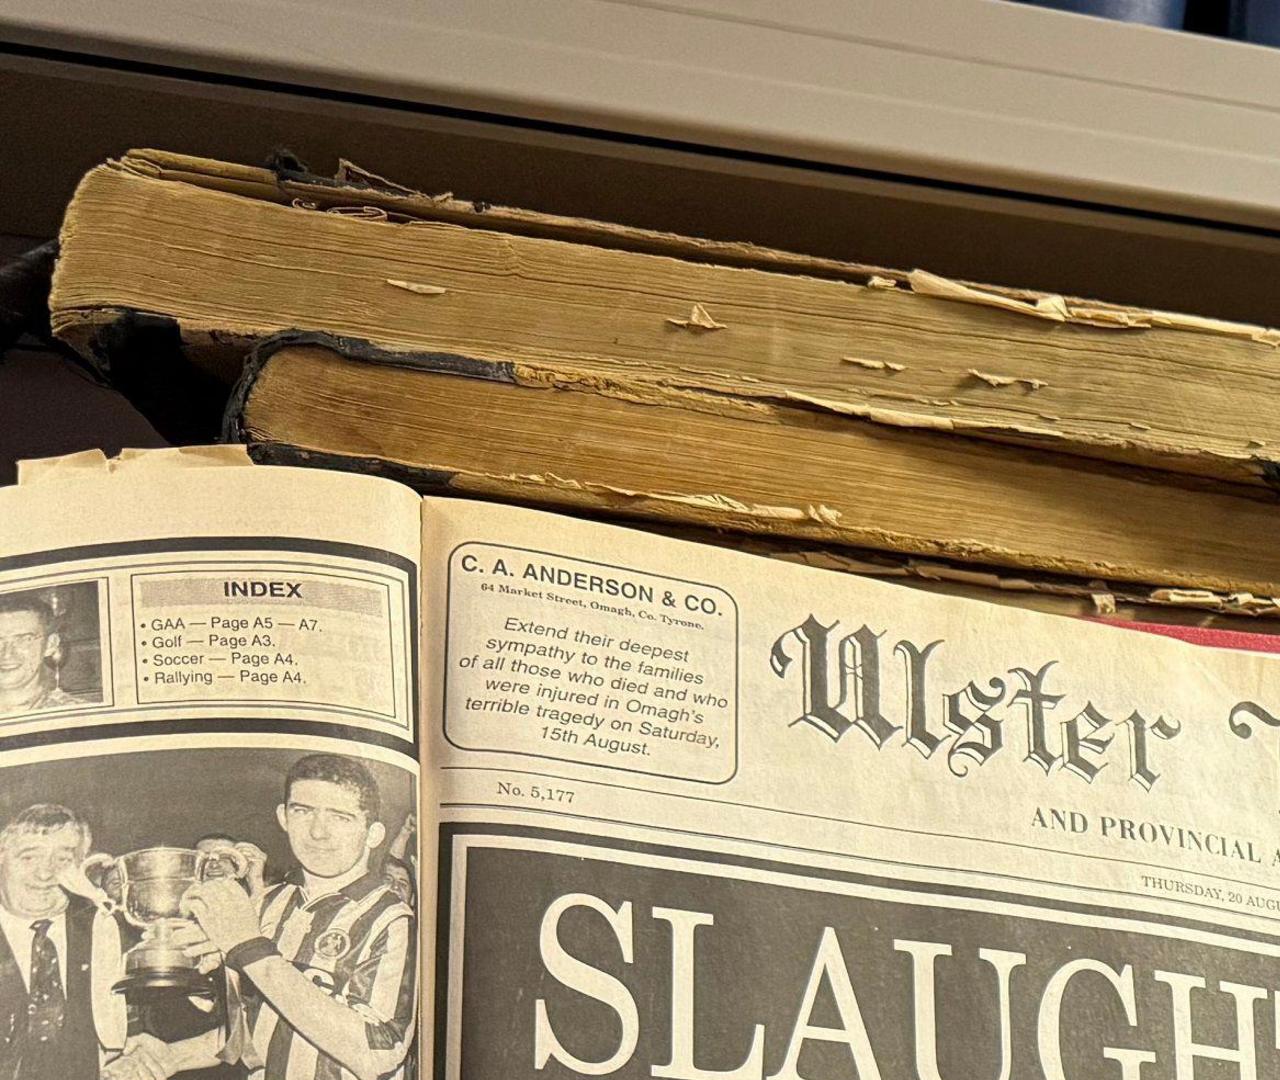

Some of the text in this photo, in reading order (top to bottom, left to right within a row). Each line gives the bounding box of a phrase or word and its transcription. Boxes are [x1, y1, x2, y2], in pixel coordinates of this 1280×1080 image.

[224, 581, 302, 597] INDEX
[461, 554, 722, 616] C. A. ANDERSON & CO.
[480, 582, 704, 630] 64 Market Street, Omagh, Co. Tyrone.
[151, 616, 322, 632] GAA Page A5 A7.
[152, 634, 275, 649] Golf Page A3.
[504, 616, 688, 662] Extend their deepest
[153, 651, 298, 667] Soccer Page A4.
[154, 669, 306, 686] Rallying Page A4.
[458, 655, 728, 708] of all those who died and who
[485, 638, 703, 684] sympathy to the families
[465, 696, 719, 749] terrible tragedy on Saturday,
[485, 679, 704, 724] were injured in Omagh's
[769, 613, 1182, 792] Ulster
[542, 726, 650, 756] 15th August.
[496, 781, 574, 803] No. 5,177
[1031, 807, 1088, 833] AND
[1100, 816, 1261, 863] PROVINCIAL
[1140, 874, 1224, 902] THURSDAY,
[1227, 890, 1242, 904] 20
